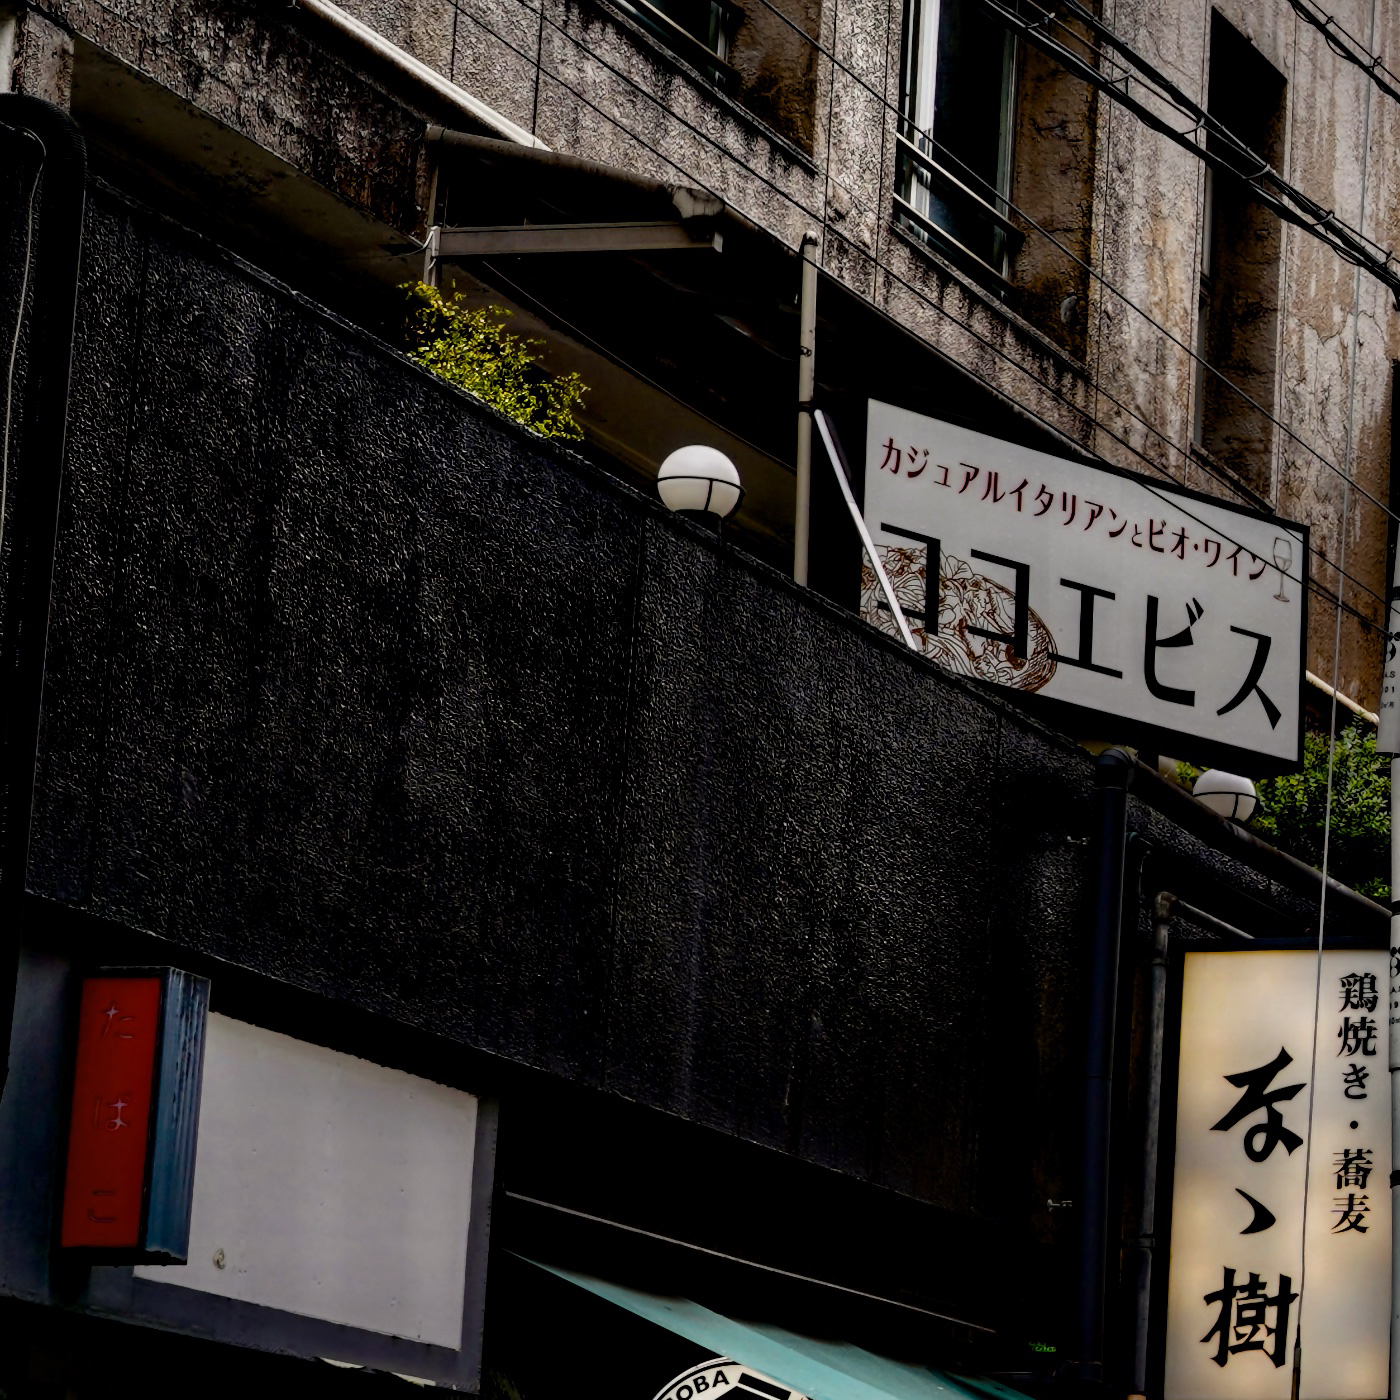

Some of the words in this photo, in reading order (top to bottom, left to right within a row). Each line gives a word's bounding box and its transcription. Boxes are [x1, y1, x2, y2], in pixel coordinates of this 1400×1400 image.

[876, 521, 1282, 731] ココエビス
[1331, 971, 1380, 1235] 鶏焼き・蕎麦
